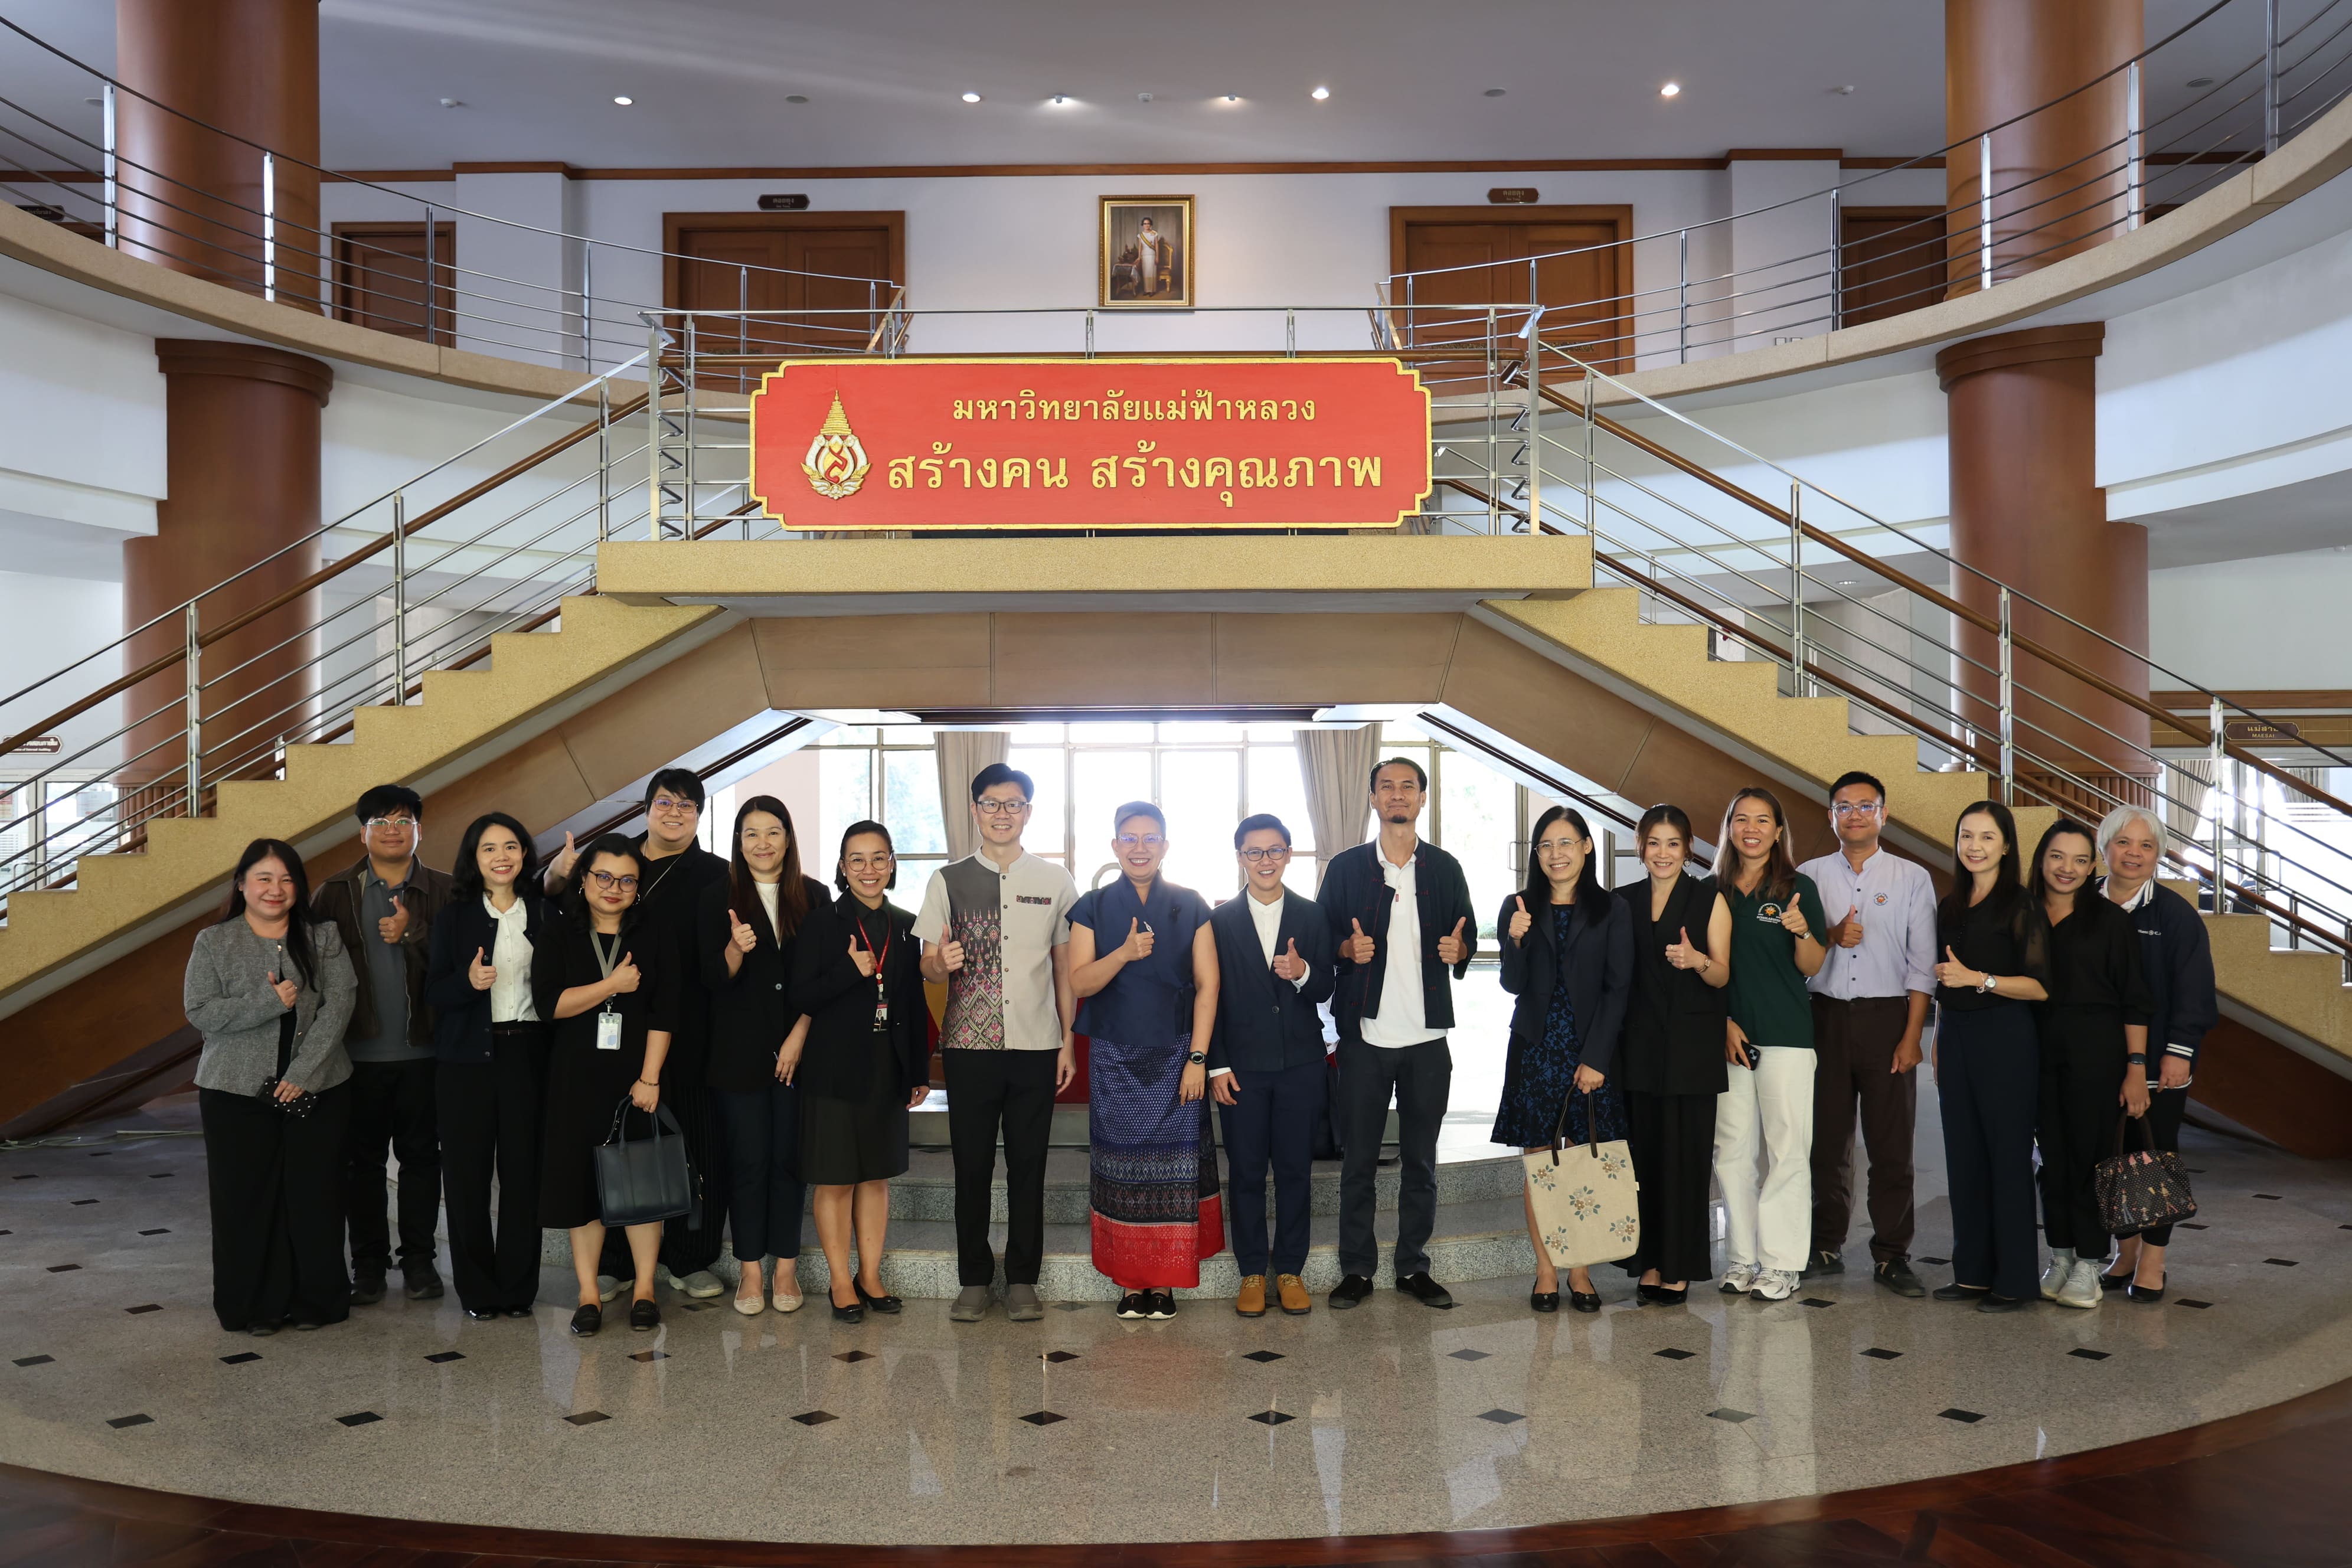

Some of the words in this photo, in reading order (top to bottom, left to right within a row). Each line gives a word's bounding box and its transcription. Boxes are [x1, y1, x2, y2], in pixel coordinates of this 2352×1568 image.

[953, 388, 1316, 421] มหาวิทยาลัยแม่ฟ้าหลวง
[887, 440, 1069, 489] สร้างคน
[1090, 439, 1381, 508] สร้างคุณภาพ
